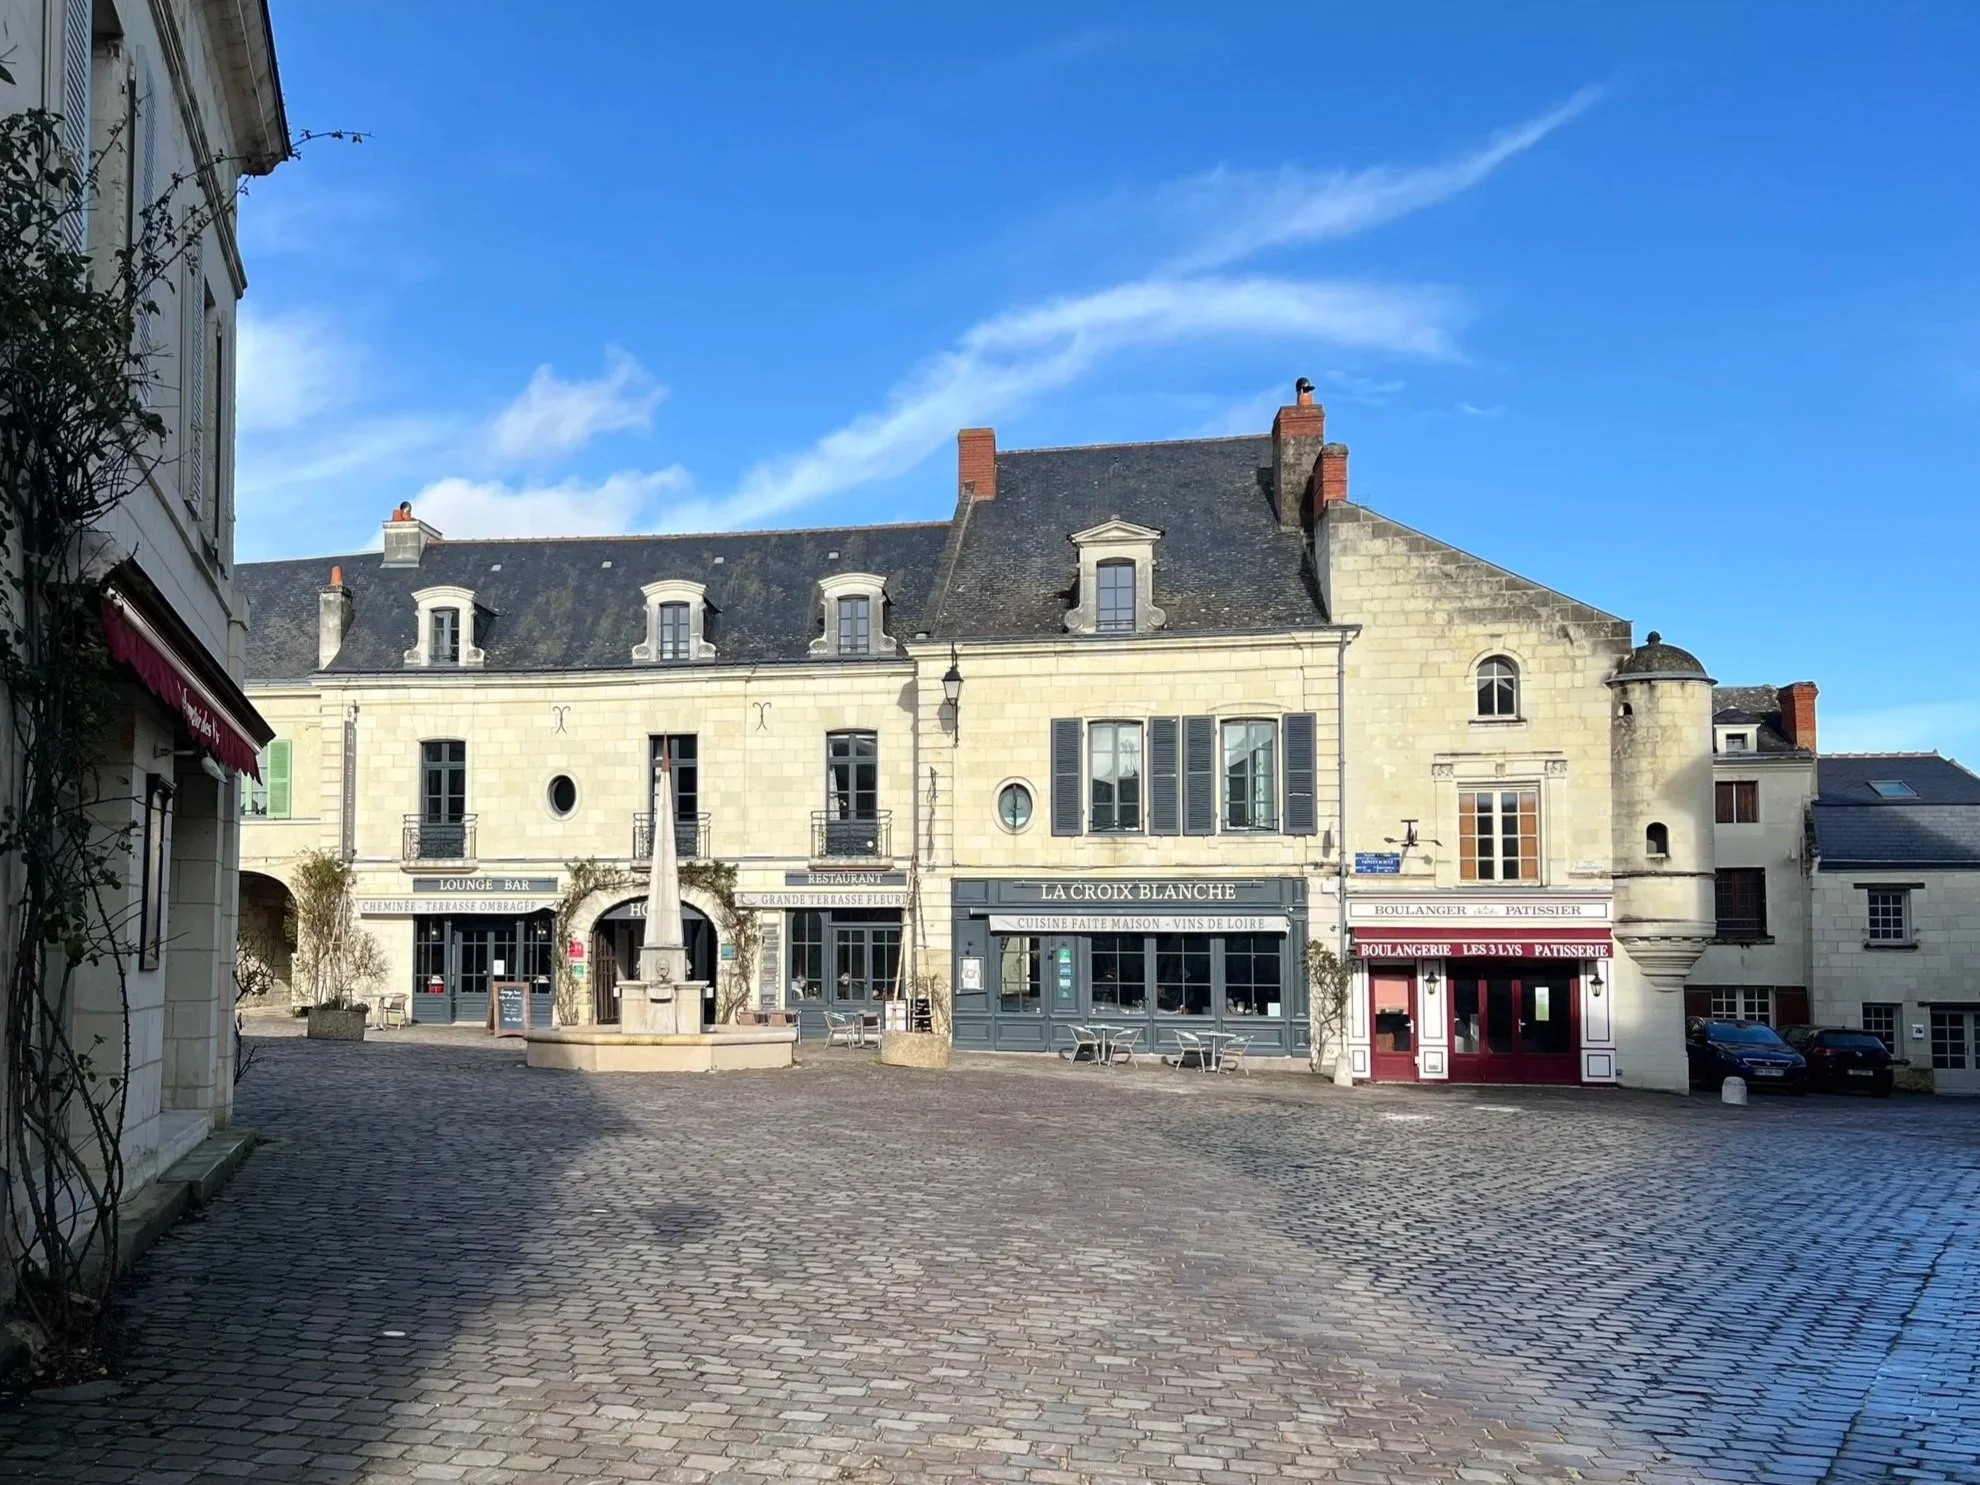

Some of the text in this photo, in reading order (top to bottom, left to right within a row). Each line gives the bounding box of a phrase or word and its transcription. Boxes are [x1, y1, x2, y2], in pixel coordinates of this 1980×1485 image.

[808, 873, 883, 884] RESTAURANT
[439, 879, 530, 891] LOUNGE BAR
[1041, 884, 1236, 899] LA CROIX BLANCHE
[761, 894, 808, 905] GRANDE
[809, 894, 864, 905] TERRASSE
[362, 900, 416, 912] CHEMINÉE
[425, 901, 476, 912] TERRASSE
[479, 900, 537, 911] OMBRAGÉE
[1374, 905, 1582, 916] BOULANGER PATISSIER
[1017, 917, 1068, 929] CUISINE
[1071, 917, 1108, 929] FAITE
[1111, 917, 1160, 929] MAISON
[1174, 917, 1204, 929] VINS
[1207, 917, 1224, 929] DE
[1227, 917, 1265, 929] LOIRE
[1360, 943, 1609, 957] BOULANGERIE LES 3 LYS PATISSERIE
